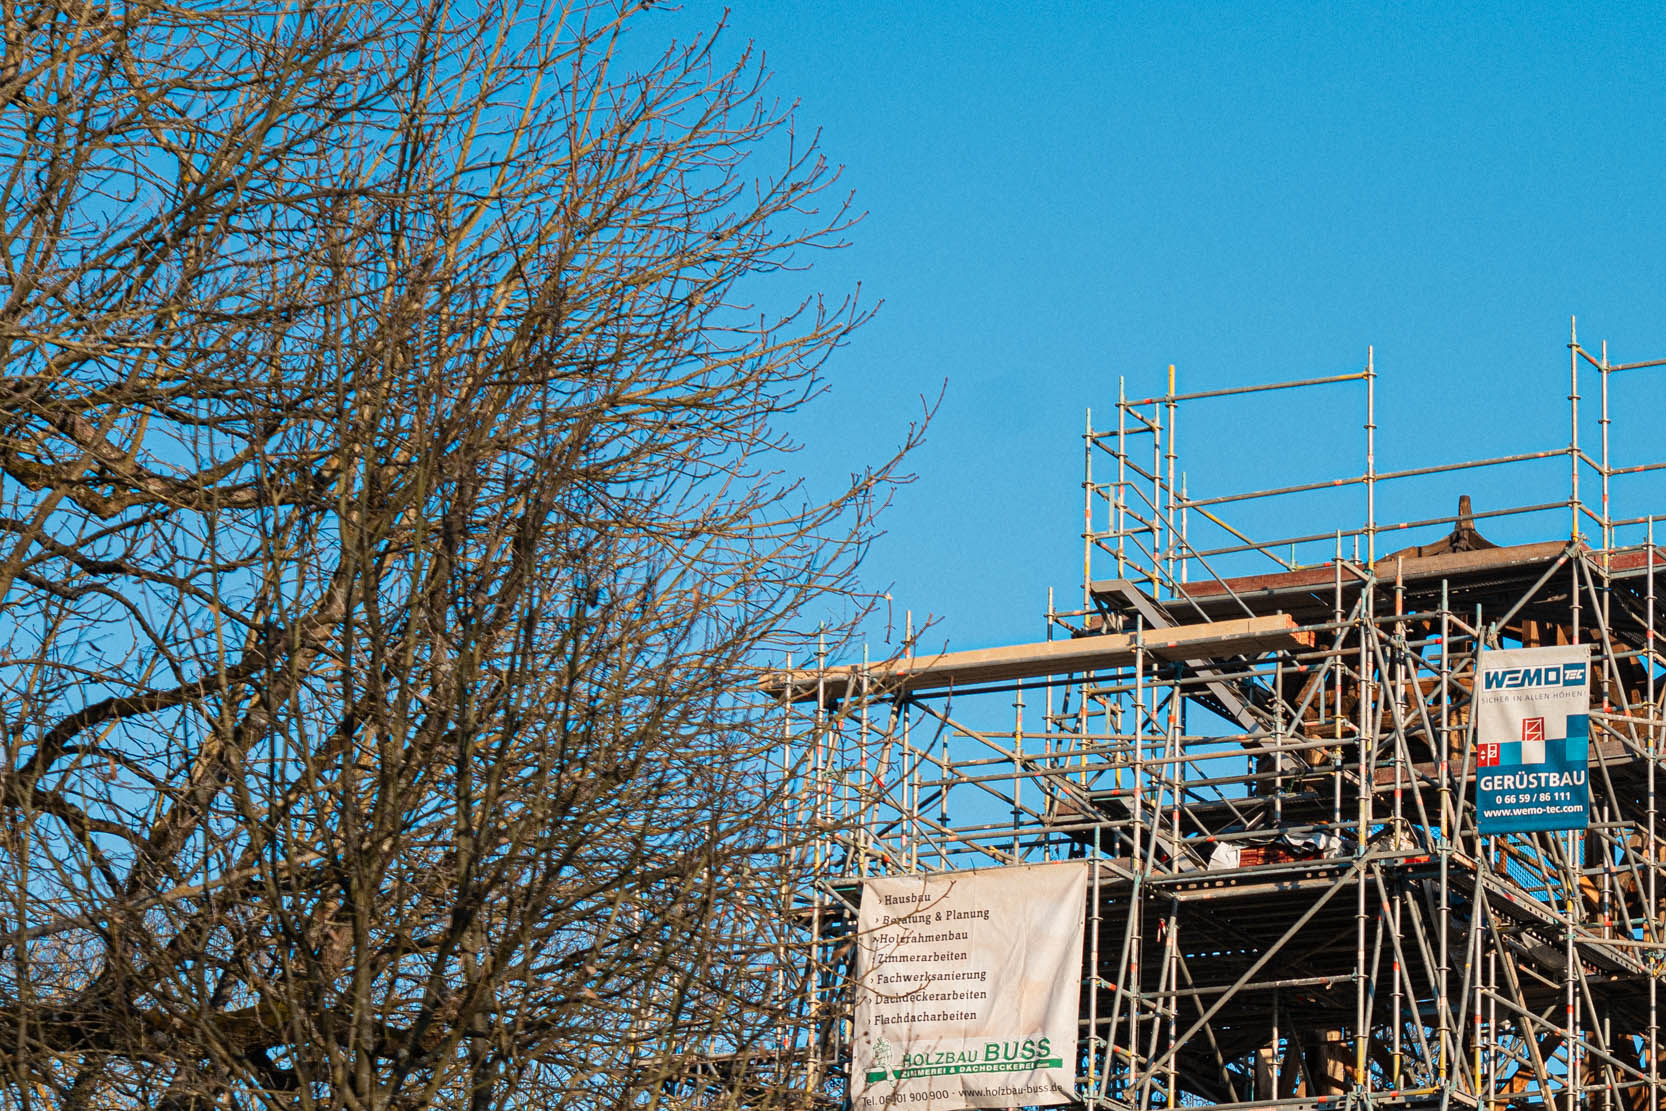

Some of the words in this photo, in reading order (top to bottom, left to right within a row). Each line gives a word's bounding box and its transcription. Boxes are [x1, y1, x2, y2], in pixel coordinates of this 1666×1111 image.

[1484, 665, 1561, 690] WEMO
[1481, 695, 1510, 705] SICHER
[1513, 694, 1522, 703] IN
[1525, 692, 1550, 702] ALLEN
[1480, 770, 1585, 791] GERÜSTBAU
[1495, 795, 1502, 805] 0
[1504, 794, 1517, 804] 66
[1519, 793, 1531, 803] 59
[1540, 792, 1551, 802] 86
[1554, 792, 1571, 801] 111
[1483, 803, 1583, 818] www.wemo-tec.com
[884, 892, 931, 906] Hausbau
[934, 911, 942, 921] &
[945, 909, 990, 920] Planung
[879, 930, 969, 944] Holzrahmenbau
[877, 951, 968, 964] Zimmerarbeiten
[876, 970, 987, 985] Fachwerksanierung
[875, 989, 987, 1005] Dachdeckerarbeiten
[874, 1010, 977, 1026] Flachdacharbeiten
[902, 1050, 978, 1068] HOLZBAU
[984, 1036, 1051, 1062] BUSS
[900, 1067, 947, 1078] ZIMMEREI
[959, 1062, 1035, 1073] DACHDECKEREI
[862, 1096, 878, 1107] Tel.
[958, 1082, 1063, 1097] www.holzbau-buss.de
